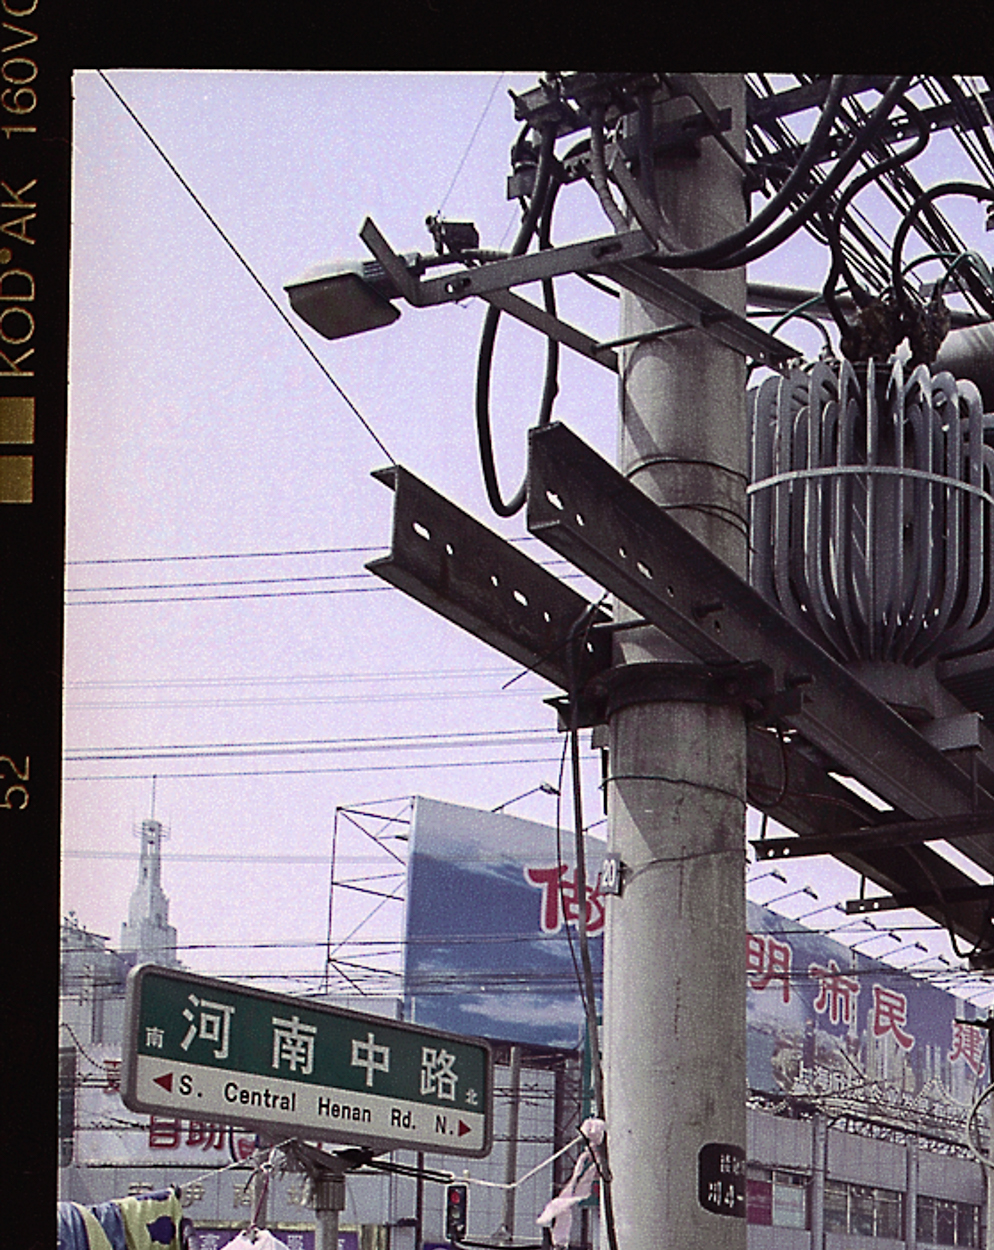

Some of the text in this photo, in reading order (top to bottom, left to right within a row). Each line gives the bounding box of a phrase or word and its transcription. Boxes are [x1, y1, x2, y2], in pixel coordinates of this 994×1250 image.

[145, 993, 479, 1106] 南 河南中路 北
[178, 1074, 454, 1136] S. Central Henan Rd. N.
